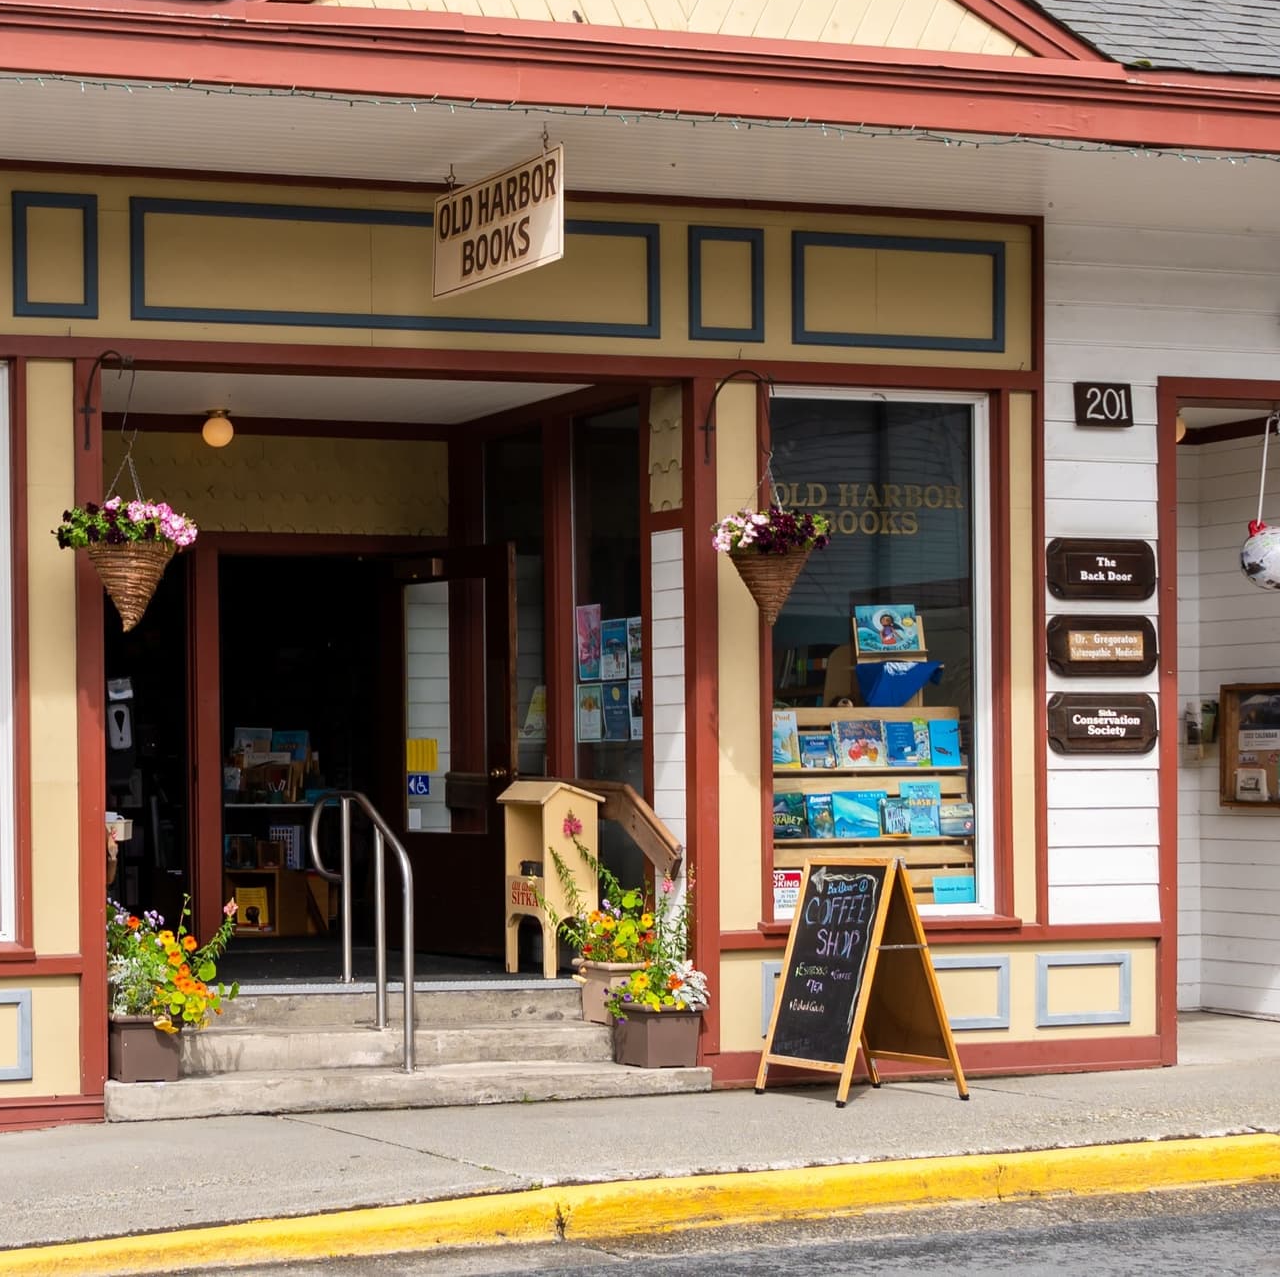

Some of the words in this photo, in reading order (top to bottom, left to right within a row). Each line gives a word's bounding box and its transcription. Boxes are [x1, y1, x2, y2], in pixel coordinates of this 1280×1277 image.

[439, 195, 473, 240] OLD
[478, 158, 557, 226] HARBOR
[462, 216, 531, 277] BOOKS
[1086, 388, 1129, 420] 201
[770, 483, 827, 507] OLD
[838, 483, 964, 509] HARBOR
[1096, 557, 1117, 567] The
[1080, 571, 1105, 581] Back
[1108, 571, 1132, 581] Door
[1075, 634, 1088, 644] Dr.
[1072, 714, 1141, 725] Conservation
[1087, 725, 1126, 737] Society
[773, 880, 800, 888] OKING
[511, 891, 539, 907] SITKA
[805, 894, 871, 926] COFFEE
[816, 928, 860, 959] SHOP
